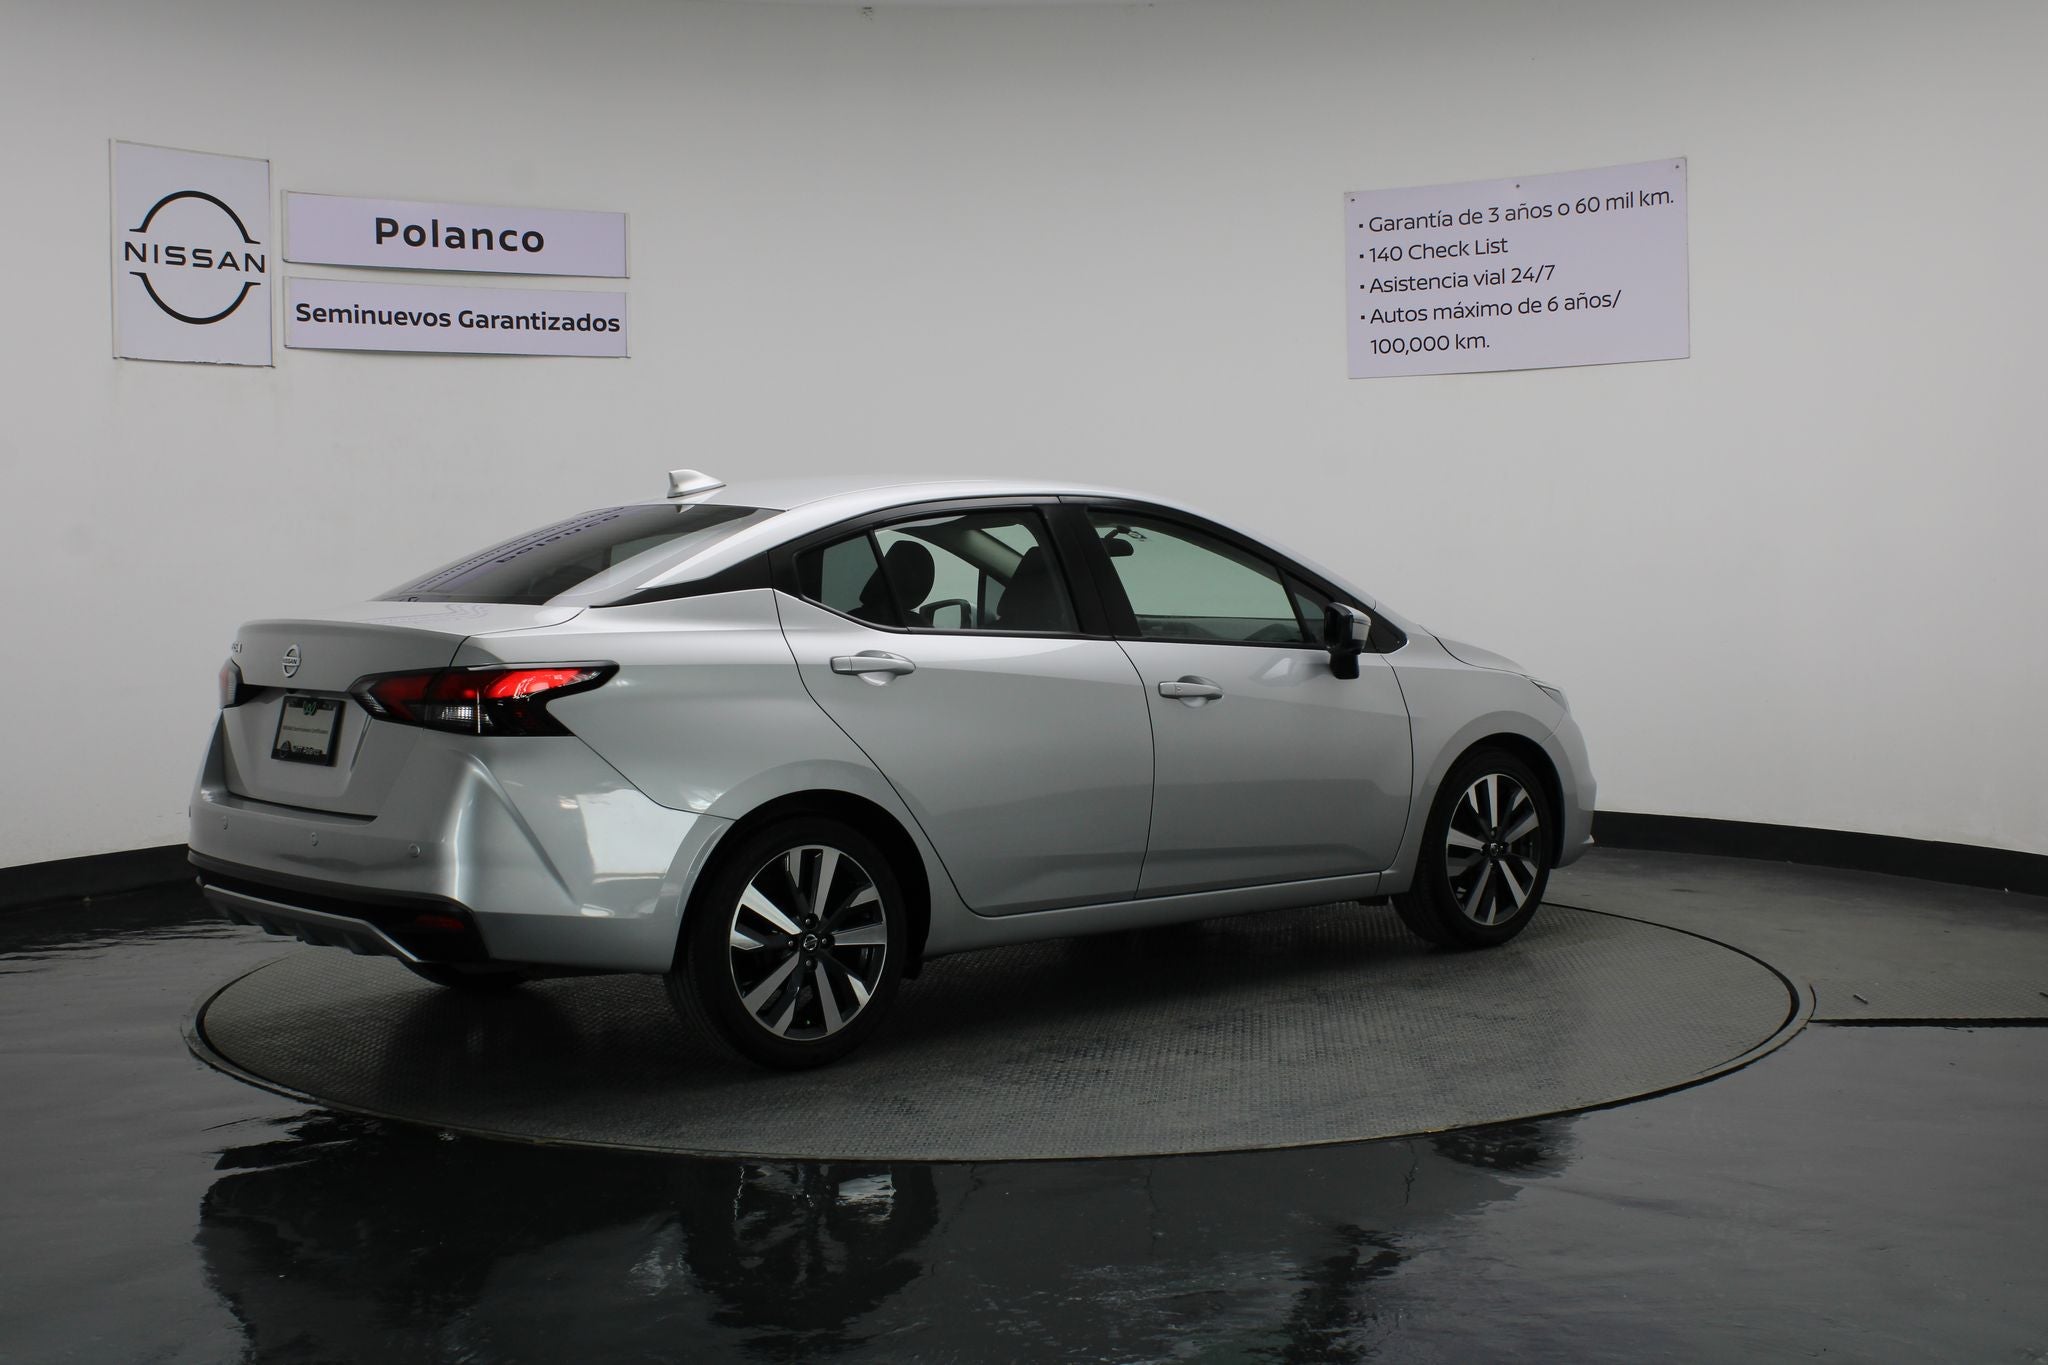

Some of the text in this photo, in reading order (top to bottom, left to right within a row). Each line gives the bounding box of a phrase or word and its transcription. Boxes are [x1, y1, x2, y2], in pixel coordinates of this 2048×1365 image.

[1368, 190, 1674, 233] Garantía de 3 años o 60 mil km.
[375, 217, 545, 253] Polanco
[1368, 237, 1509, 263] 140 Check List
[124, 241, 266, 274] NISSAN
[1369, 264, 1556, 294] Asistencia vial 24/7
[295, 302, 621, 333] Seminuevos Garantizados
[1369, 289, 1622, 325] Autos máximo de 6 años/
[1370, 333, 1490, 356] 100,000 km.
